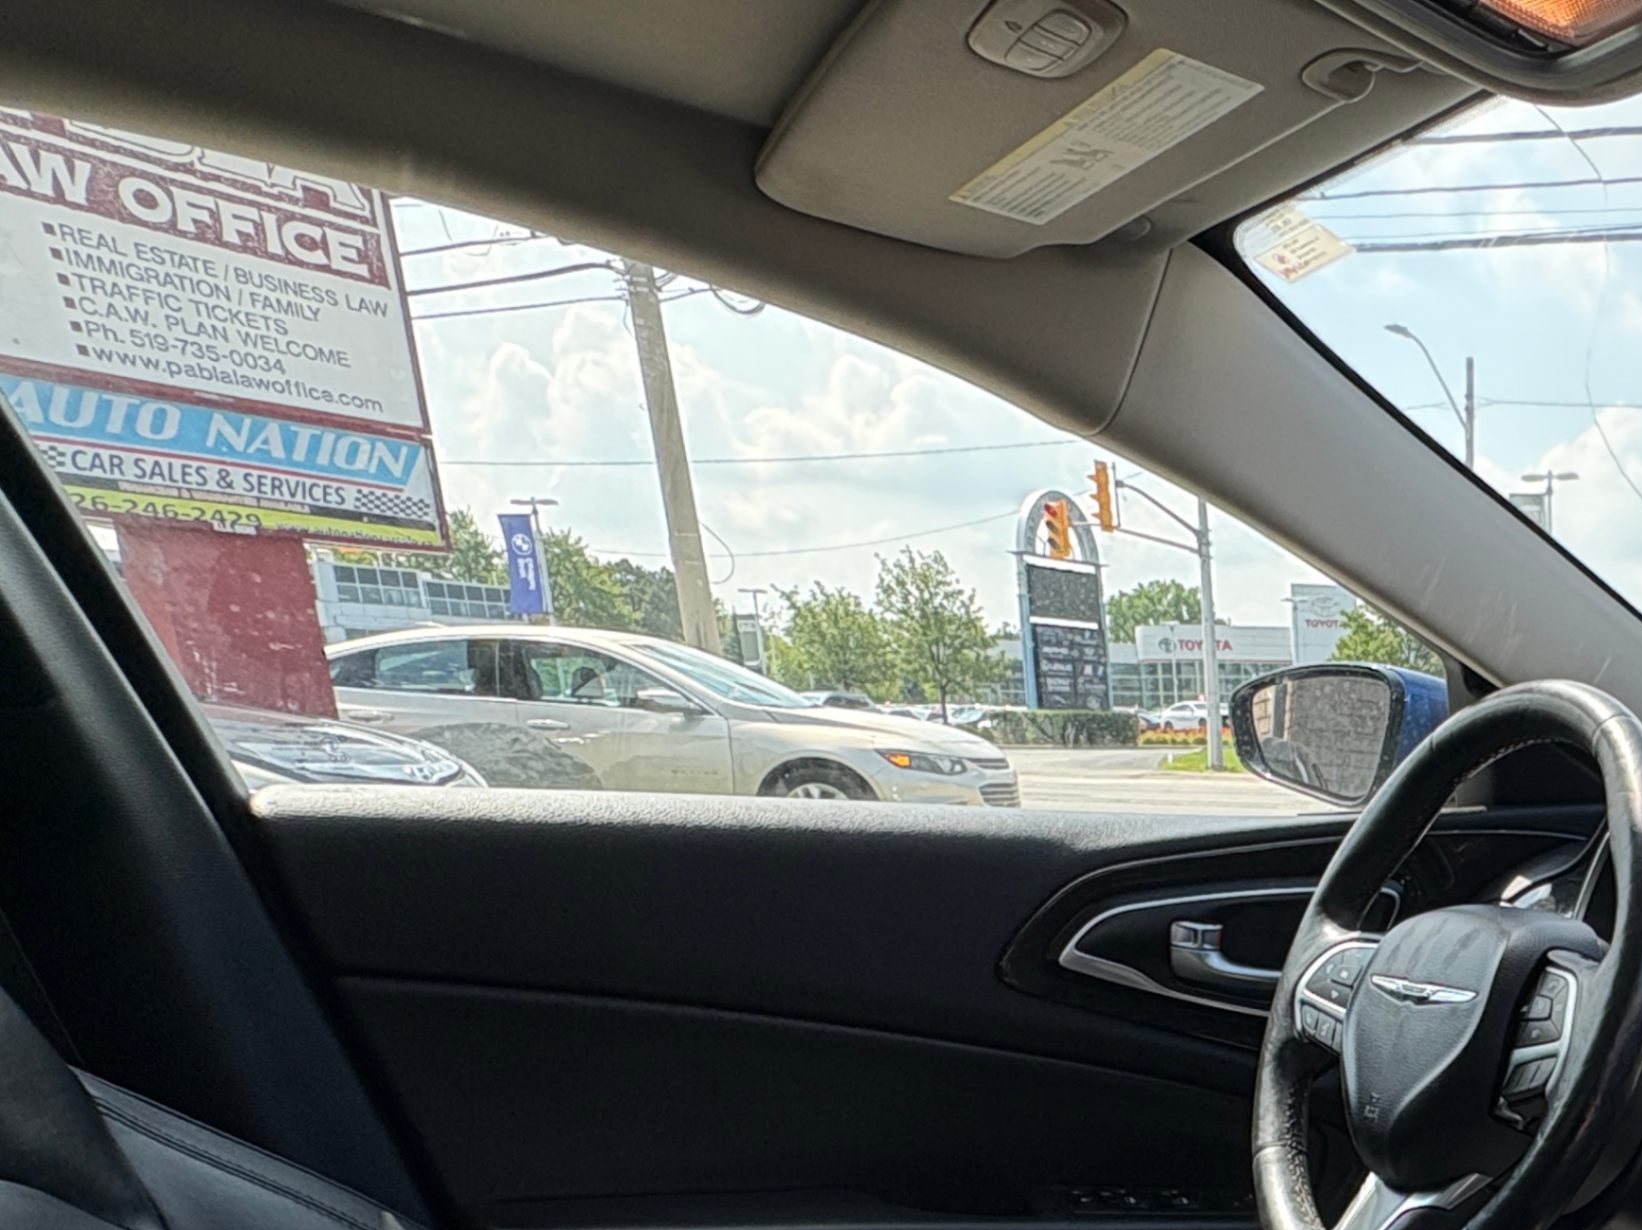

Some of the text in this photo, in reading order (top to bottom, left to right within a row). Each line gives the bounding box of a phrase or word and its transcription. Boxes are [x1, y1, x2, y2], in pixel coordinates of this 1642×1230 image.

[118, 176, 370, 280] OFFICE
[58, 222, 128, 257] REAL
[133, 242, 218, 279] ESTATE
[233, 266, 339, 307] BUSINESS
[345, 293, 388, 318] LAW
[65, 248, 231, 299] IMMIGRATION
[249, 291, 321, 323] FAMILY
[71, 272, 289, 336] TRAFFIC TICKETS
[78, 296, 352, 369] C.A.W. PLAN WELCOME
[84, 320, 287, 375] Ph. 519-735-0034
[92, 346, 384, 413] www.pablalawoffice.com
[10, 380, 409, 479] AUTO NATION
[71, 449, 346, 506] CAR SALES & SERVICES
[1177, 638, 1233, 652] TOYTA
[1304, 618, 1342, 629] TOYOT
